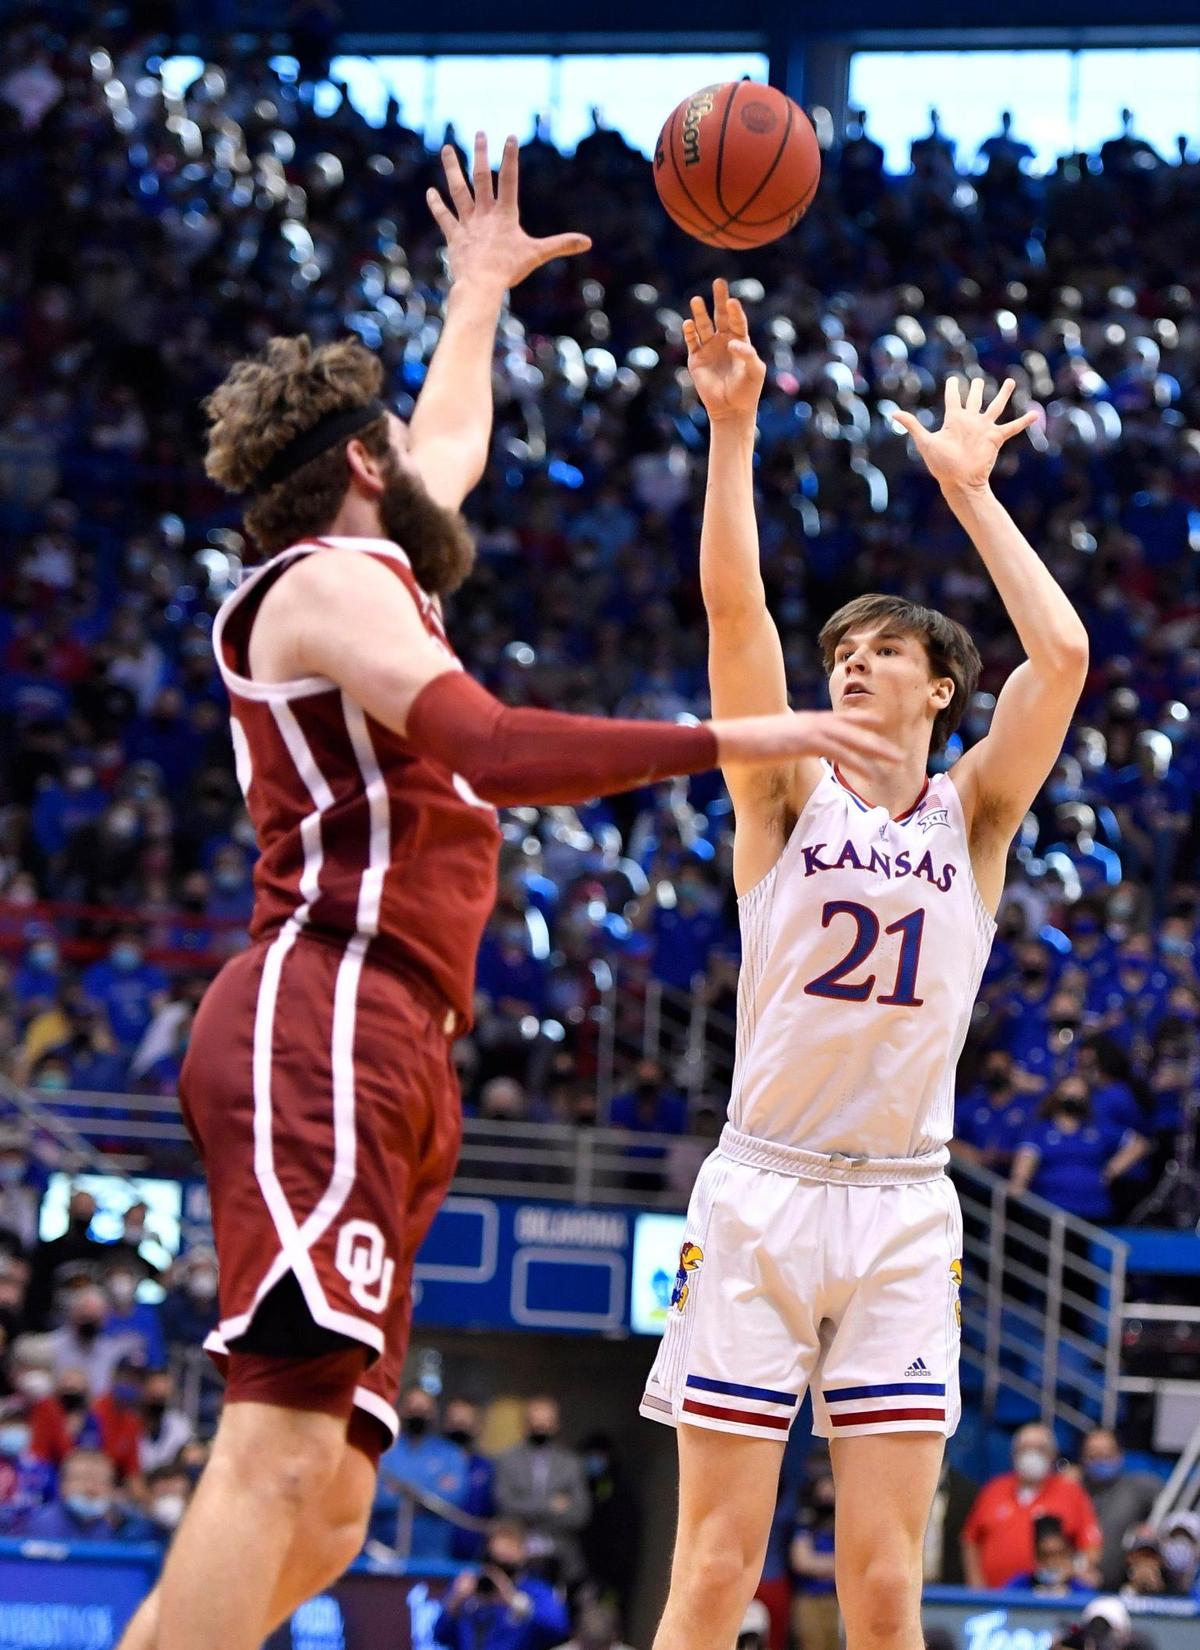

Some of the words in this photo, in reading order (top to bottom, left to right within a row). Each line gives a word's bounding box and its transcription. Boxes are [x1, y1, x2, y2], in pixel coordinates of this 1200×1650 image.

[801, 840, 957, 892] KANSAS
[803, 900, 926, 1007] 21
[335, 1219, 394, 1313] OU
[904, 1369, 932, 1377] adidas
